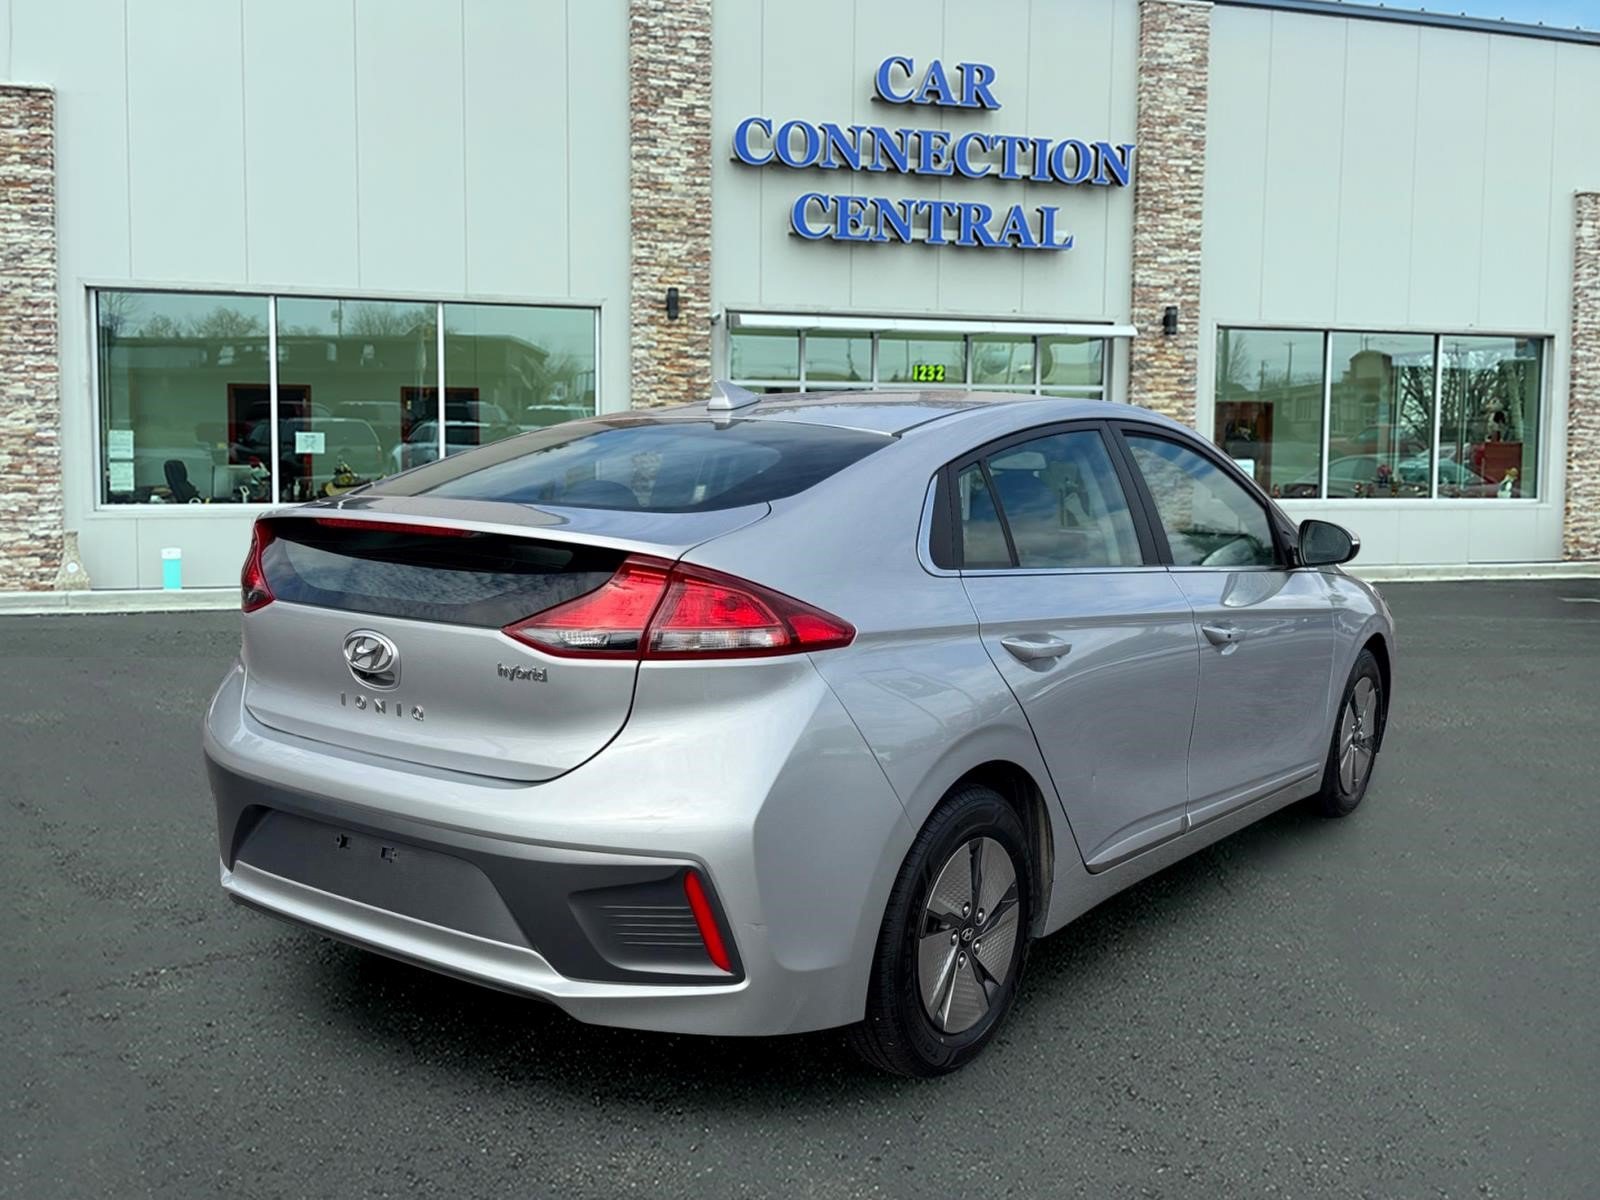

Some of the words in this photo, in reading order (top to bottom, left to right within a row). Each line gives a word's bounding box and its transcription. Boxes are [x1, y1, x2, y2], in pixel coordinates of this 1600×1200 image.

[874, 55, 1001, 109] CAR
[733, 116, 1136, 187] CONNECTION
[790, 192, 1075, 250] CENTRAL
[913, 365, 945, 381] 1232
[497, 663, 548, 683] hybrid
[340, 692, 425, 721] IONIQ
